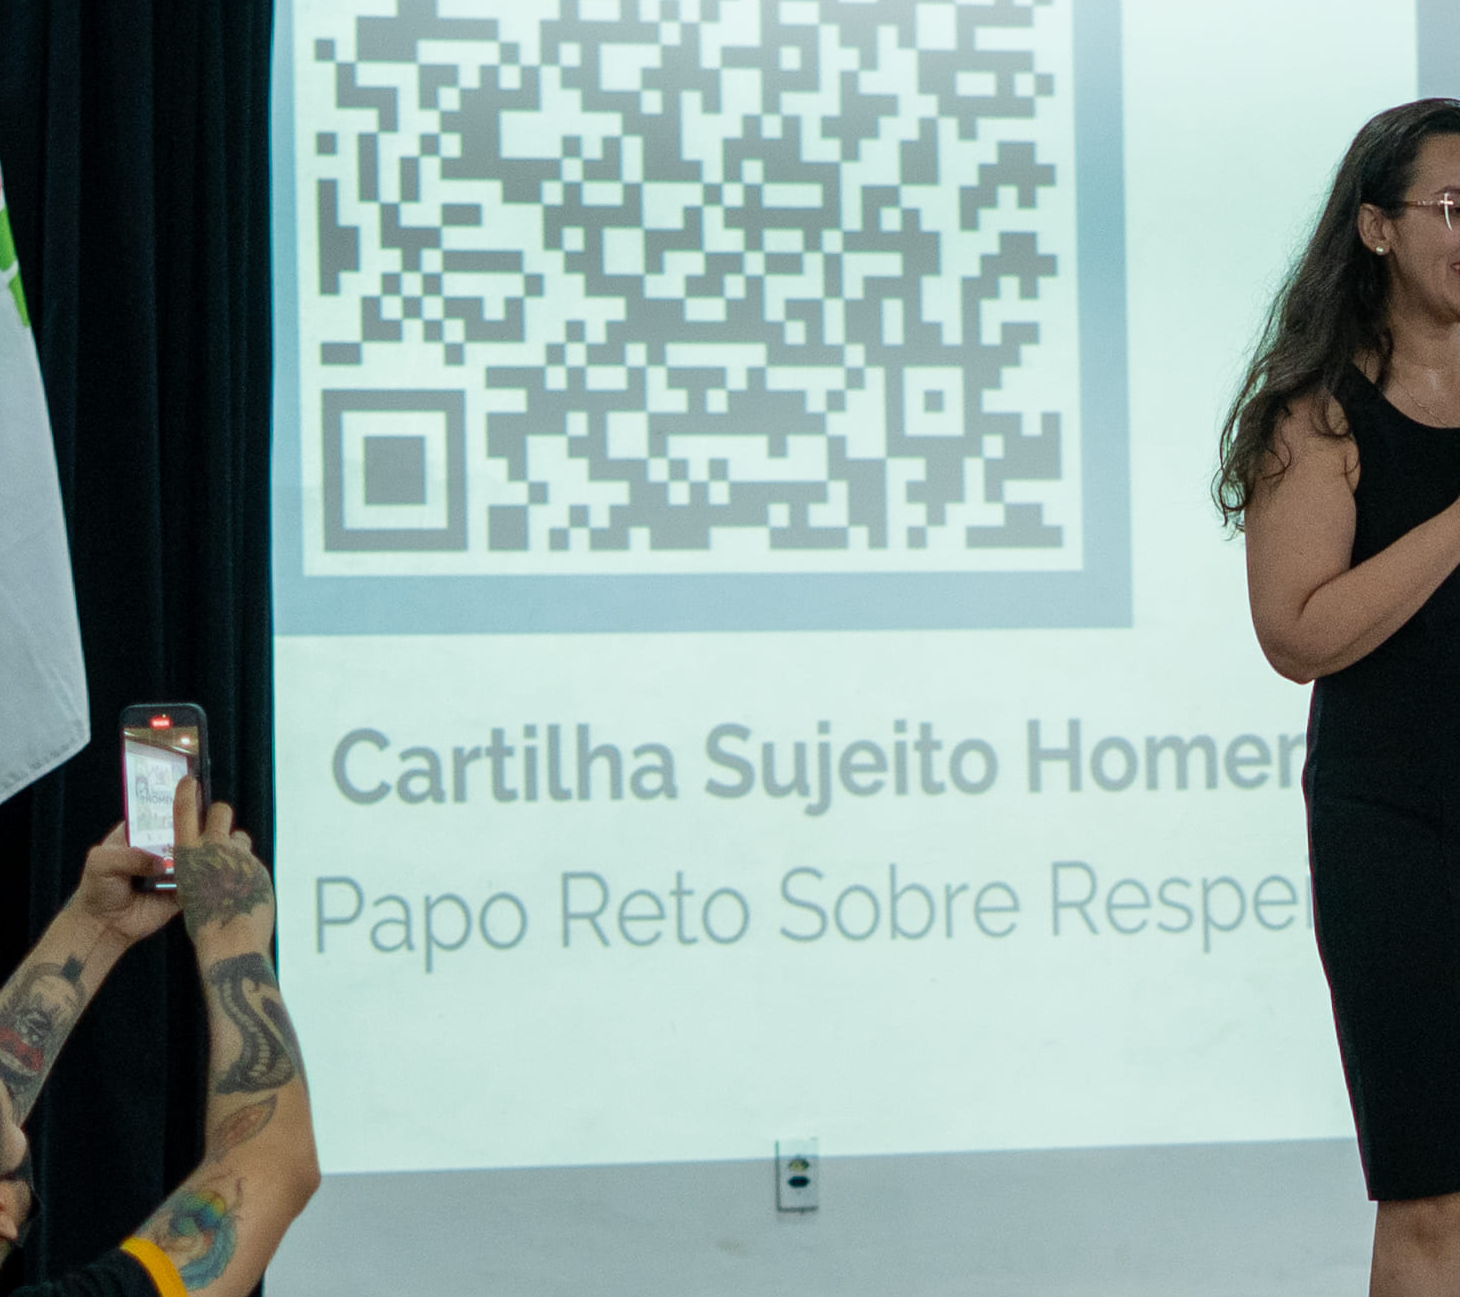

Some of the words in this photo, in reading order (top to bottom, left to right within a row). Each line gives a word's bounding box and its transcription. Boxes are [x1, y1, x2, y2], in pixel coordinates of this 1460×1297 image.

[331, 722, 678, 805] Cartilha
[704, 718, 999, 818] Sujeito
[315, 875, 528, 974] Papo
[561, 870, 751, 948] Reto
[779, 863, 1020, 943] Sobre
